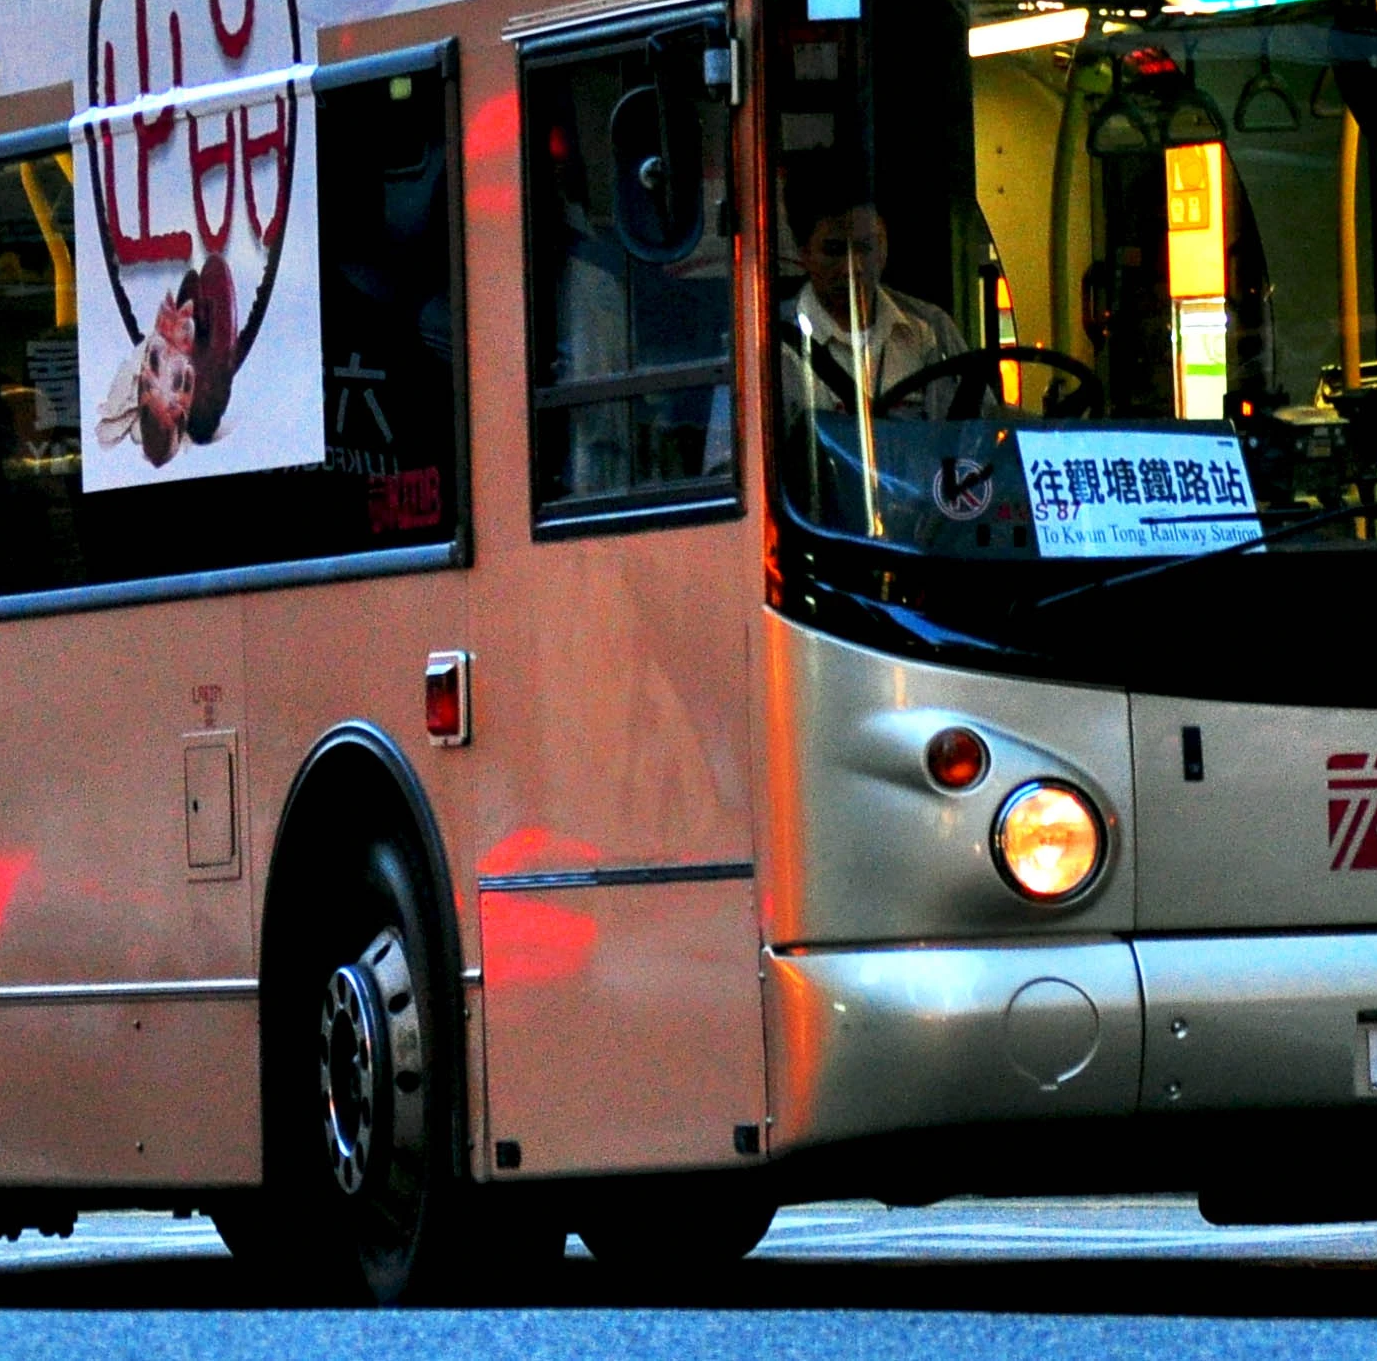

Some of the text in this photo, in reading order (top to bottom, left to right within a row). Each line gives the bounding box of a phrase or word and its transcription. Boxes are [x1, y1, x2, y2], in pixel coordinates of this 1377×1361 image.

[1031, 458, 1248, 509] 往觀塘鐵路站
[1056, 501, 1083, 522] 87
[1042, 524, 1059, 543] To
[1111, 525, 1147, 546] Tong
[1150, 524, 1208, 547] Railway
[1211, 525, 1259, 544] Station
